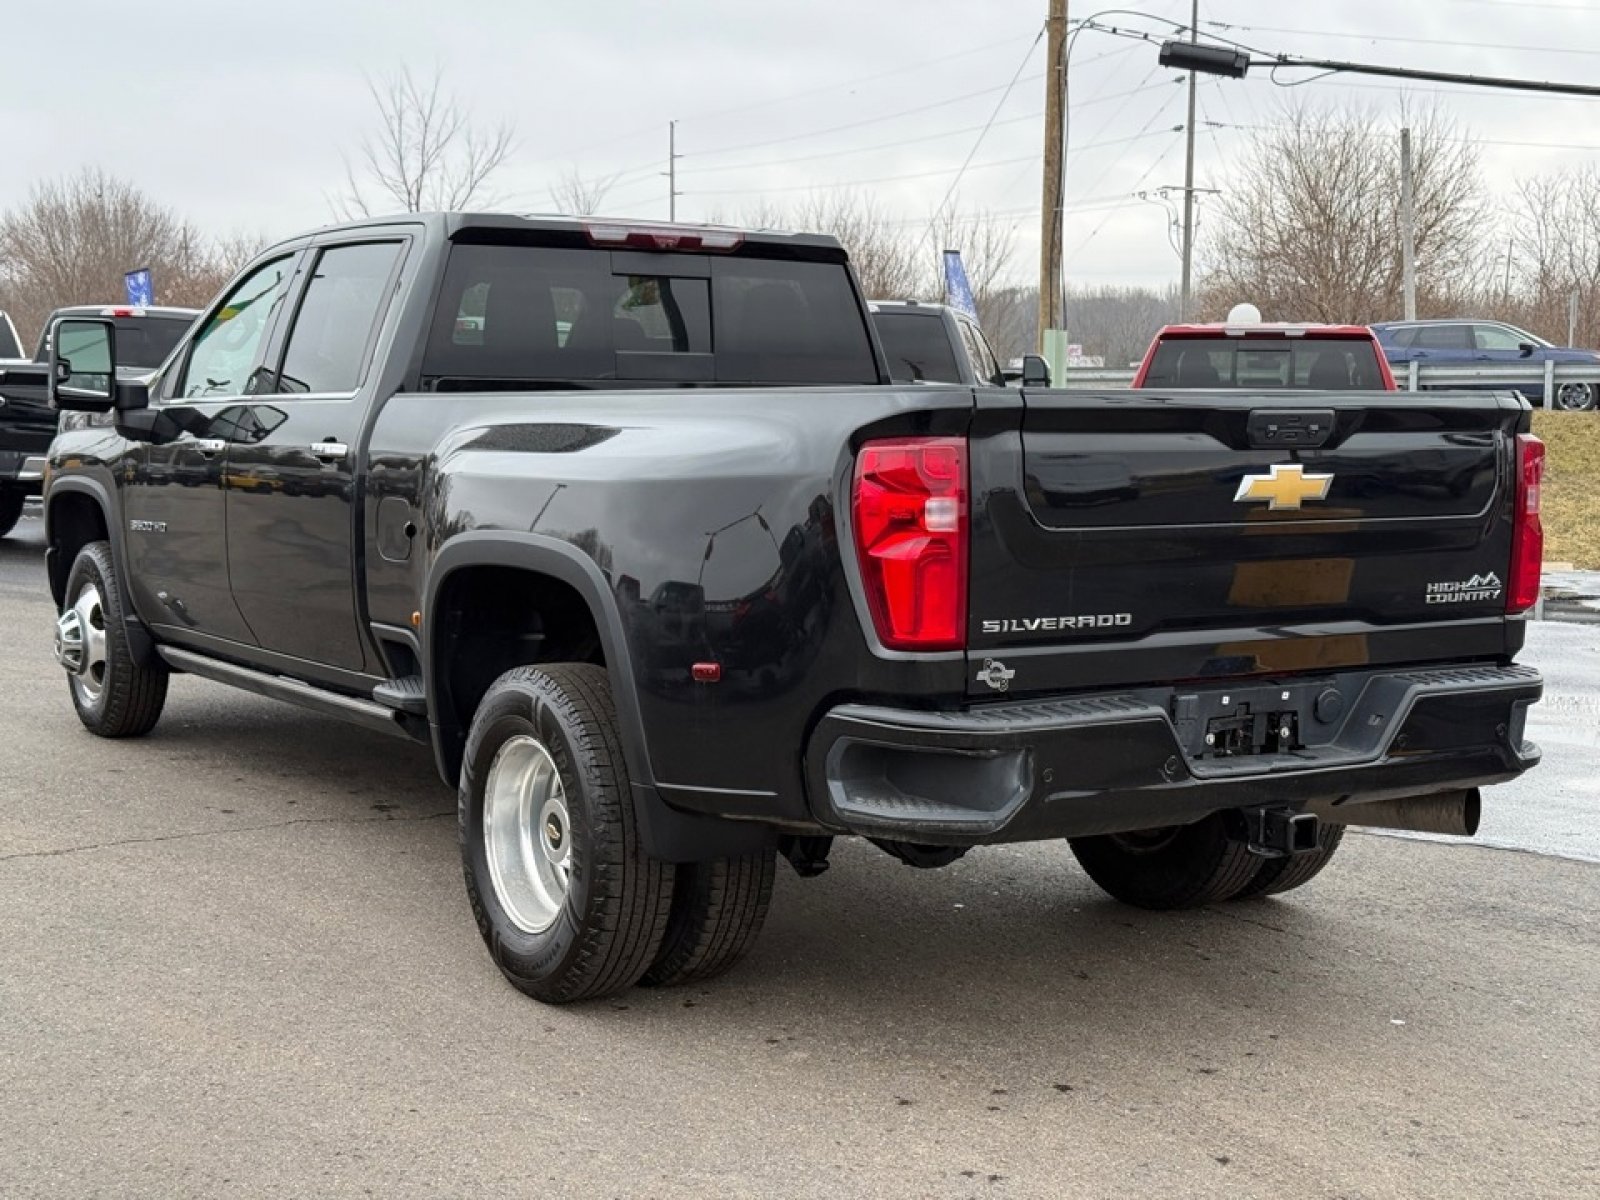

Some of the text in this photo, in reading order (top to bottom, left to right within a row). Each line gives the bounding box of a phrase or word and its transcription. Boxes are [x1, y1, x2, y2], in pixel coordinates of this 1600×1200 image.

[1427, 581, 1467, 593] HIGH
[1425, 589, 1501, 604] COUNTRY
[982, 612, 1132, 633] SILVERADO
